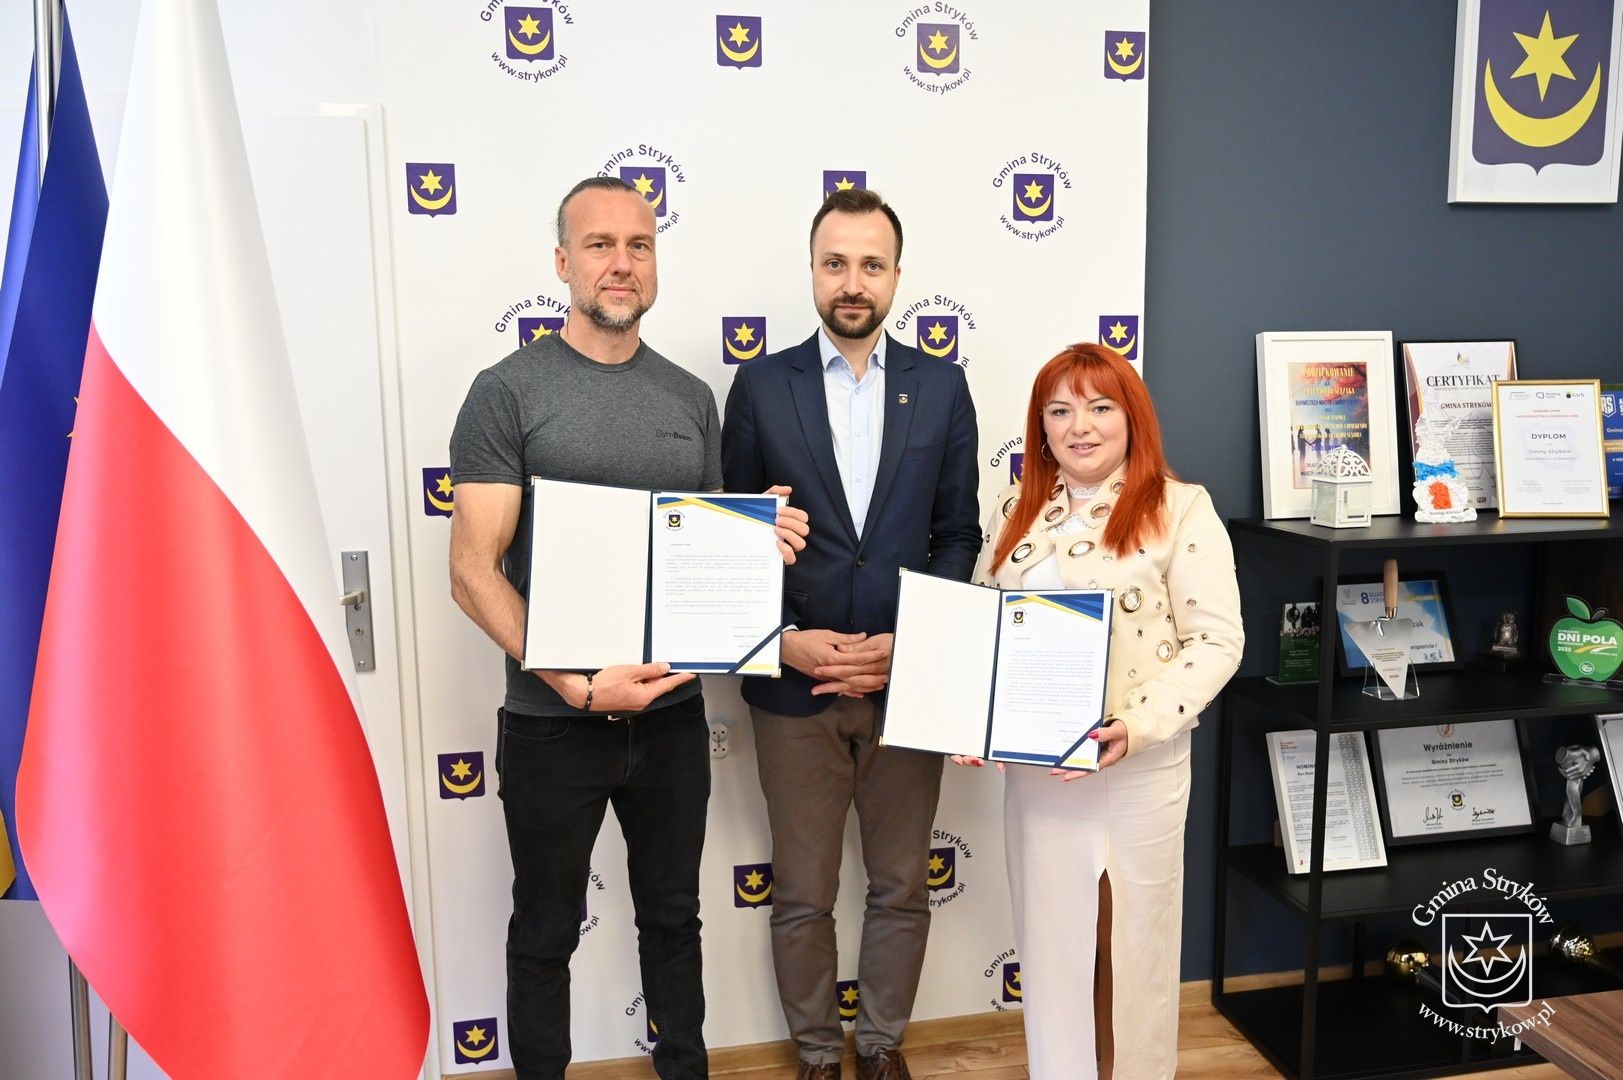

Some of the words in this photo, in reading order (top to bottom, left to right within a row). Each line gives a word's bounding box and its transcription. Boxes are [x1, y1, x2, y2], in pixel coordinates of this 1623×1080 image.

[895, 3, 931, 38] Gmina
[934, 1, 978, 41] Stryków
[491, 52, 568, 83] www.strykow.pl
[903, 64, 972, 95] www.strykow.pl
[597, 148, 634, 178] Gmina
[638, 144, 686, 183] Stryków
[992, 154, 1027, 188] Gmina
[1031, 152, 1072, 190] Stryków
[1000, 214, 1065, 242] www.strykow.pl
[495, 299, 532, 333] Gmina
[537, 295, 571, 314] Stryk
[895, 296, 930, 331] Gmina
[934, 294, 977, 331] Stryków
[1463, 400, 1492, 409] STRYKÓW
[990, 436, 1023, 468] Gmina
[1360, 592, 1370, 605] 8
[1557, 632, 1580, 642] DNI
[1582, 634, 1618, 646] POLA
[1423, 741, 1473, 752] Wyróżnienie
[932, 829, 972, 859] Stryków
[928, 882, 966, 908] trykow.pl
[984, 948, 1016, 978] Gmina
[625, 991, 645, 1016] Gmi
